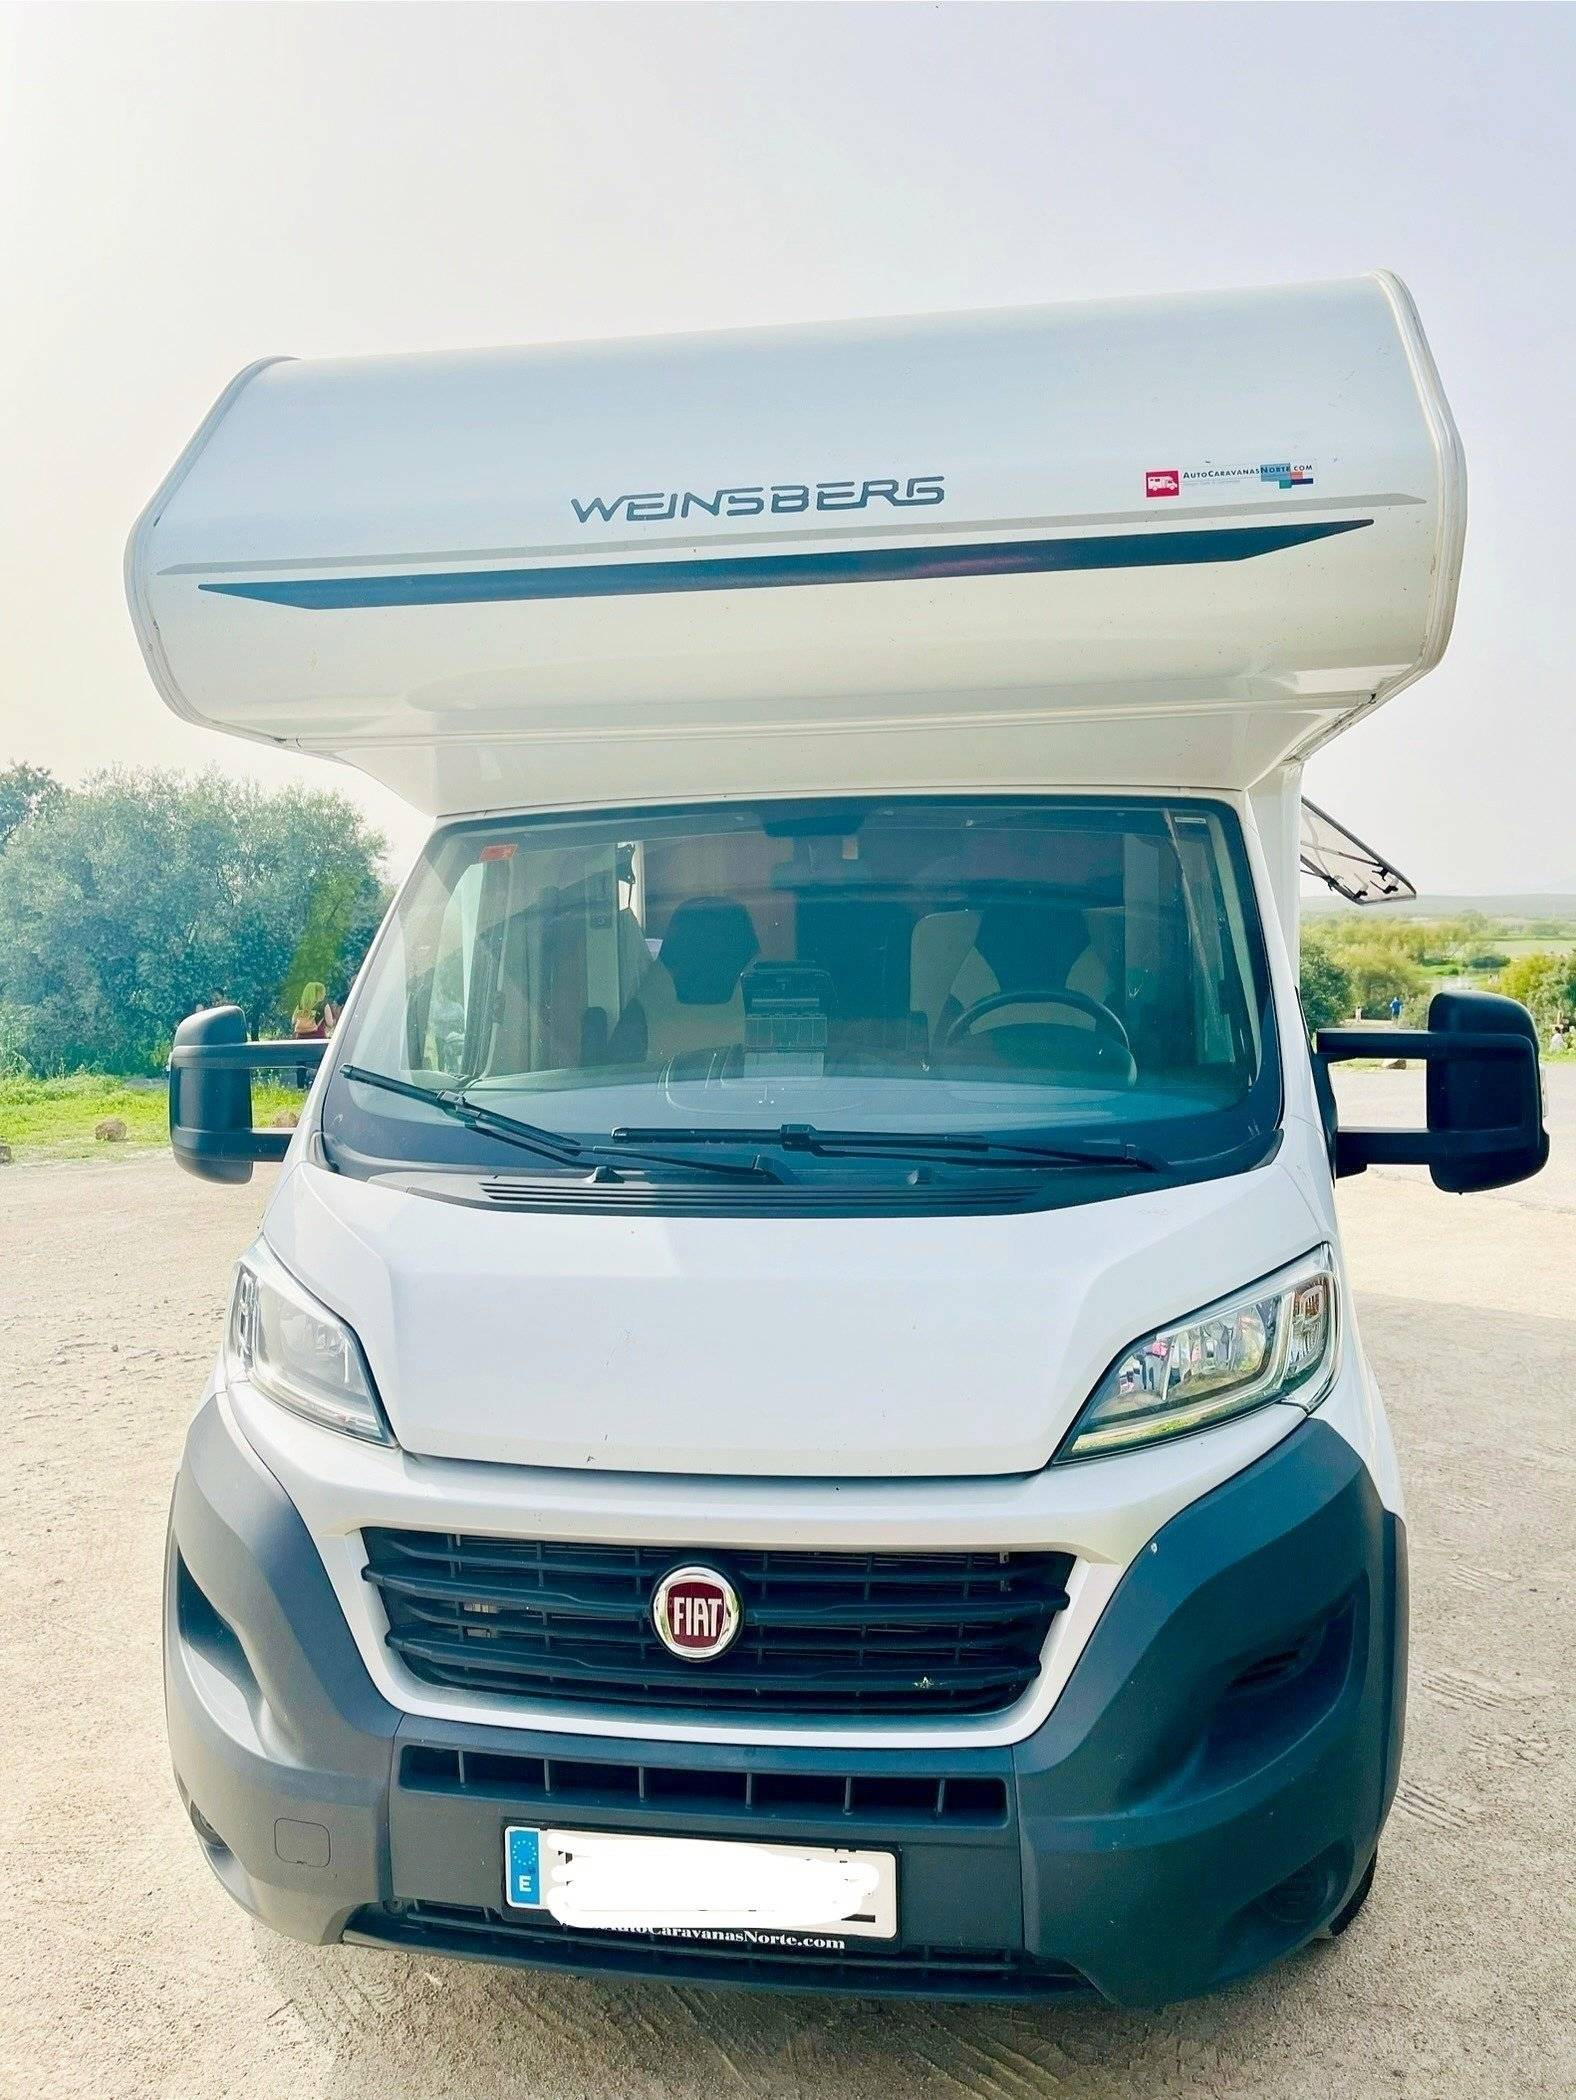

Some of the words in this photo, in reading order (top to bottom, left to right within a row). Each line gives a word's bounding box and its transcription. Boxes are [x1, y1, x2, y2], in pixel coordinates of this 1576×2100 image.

[570, 475, 945, 523] WEINSBERG
[673, 1596, 722, 1637] FIAT
[518, 1874, 532, 1892] E
